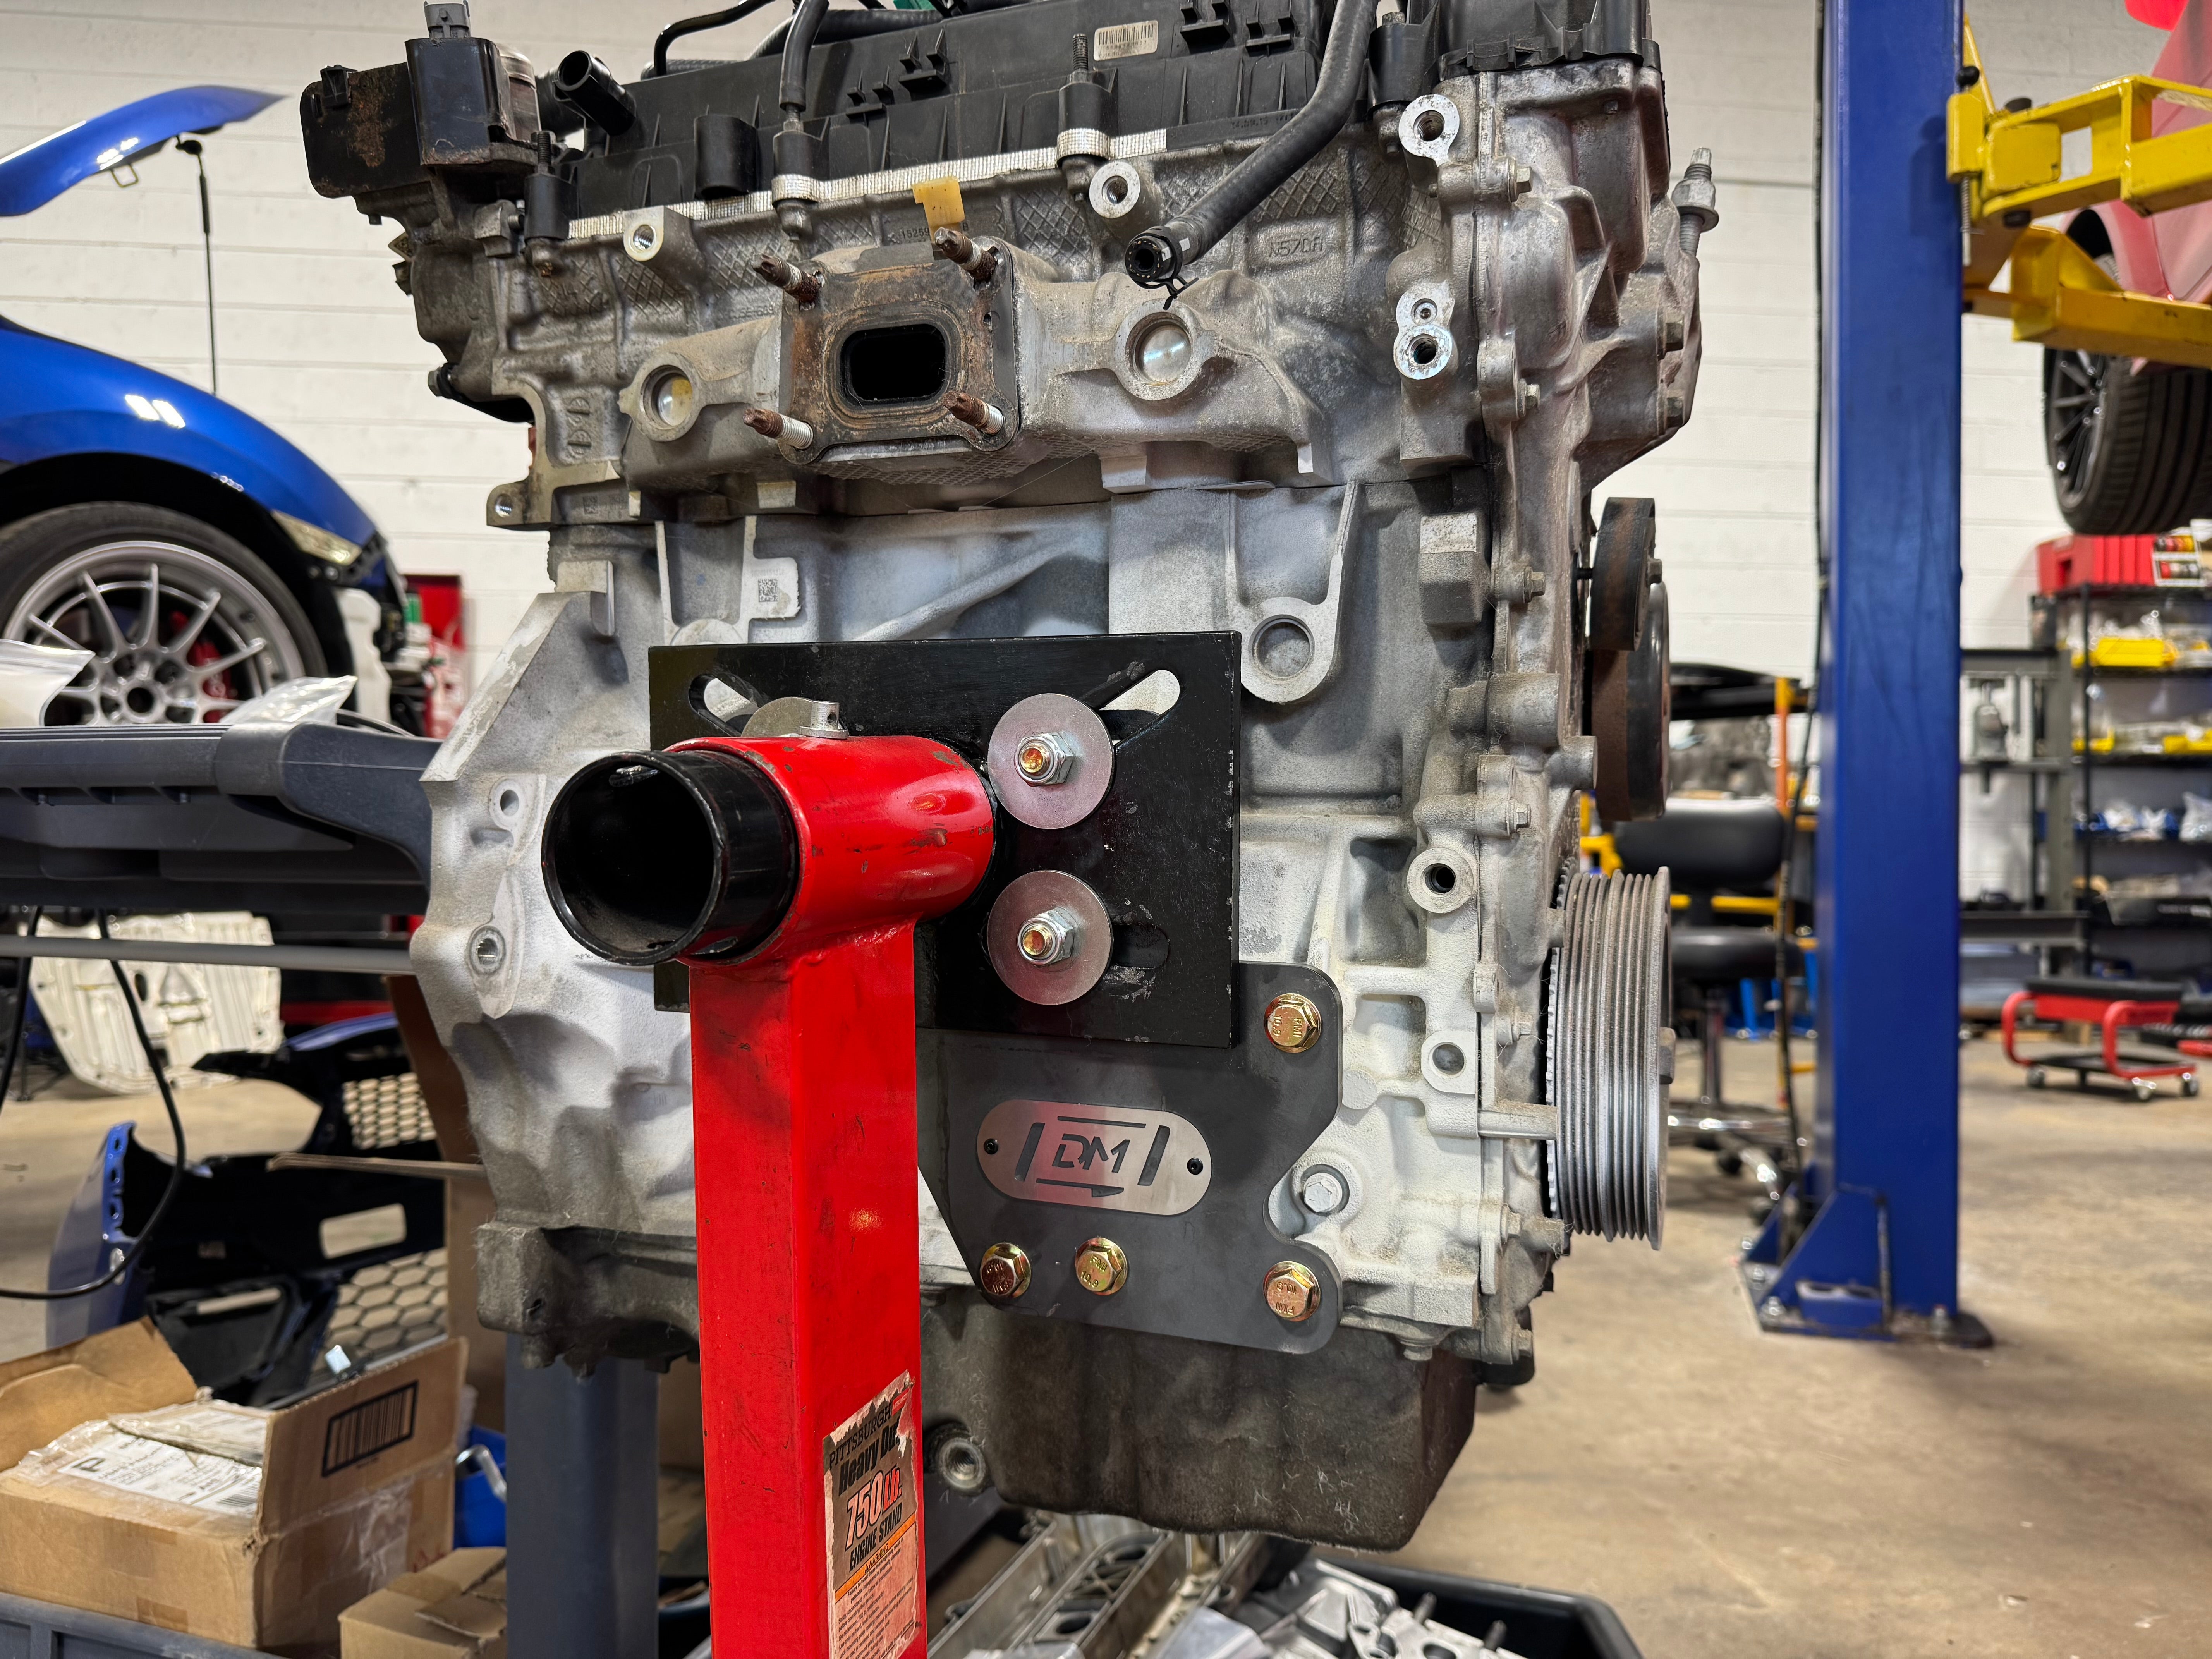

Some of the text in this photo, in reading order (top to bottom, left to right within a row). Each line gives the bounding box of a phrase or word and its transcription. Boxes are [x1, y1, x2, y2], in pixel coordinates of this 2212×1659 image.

[1081, 1271, 1099, 1288] 10.9
[1277, 1282, 1297, 1295] 10.9
[1276, 1302, 1295, 1316] FMI
[830, 1406, 891, 1470] PITTSBURGH
[839, 1438, 879, 1496] Heavy
[845, 1463, 903, 1552] 750 Lb.
[850, 1502, 902, 1572] ENGINE STAND
[868, 1542, 889, 1569] WARNING
